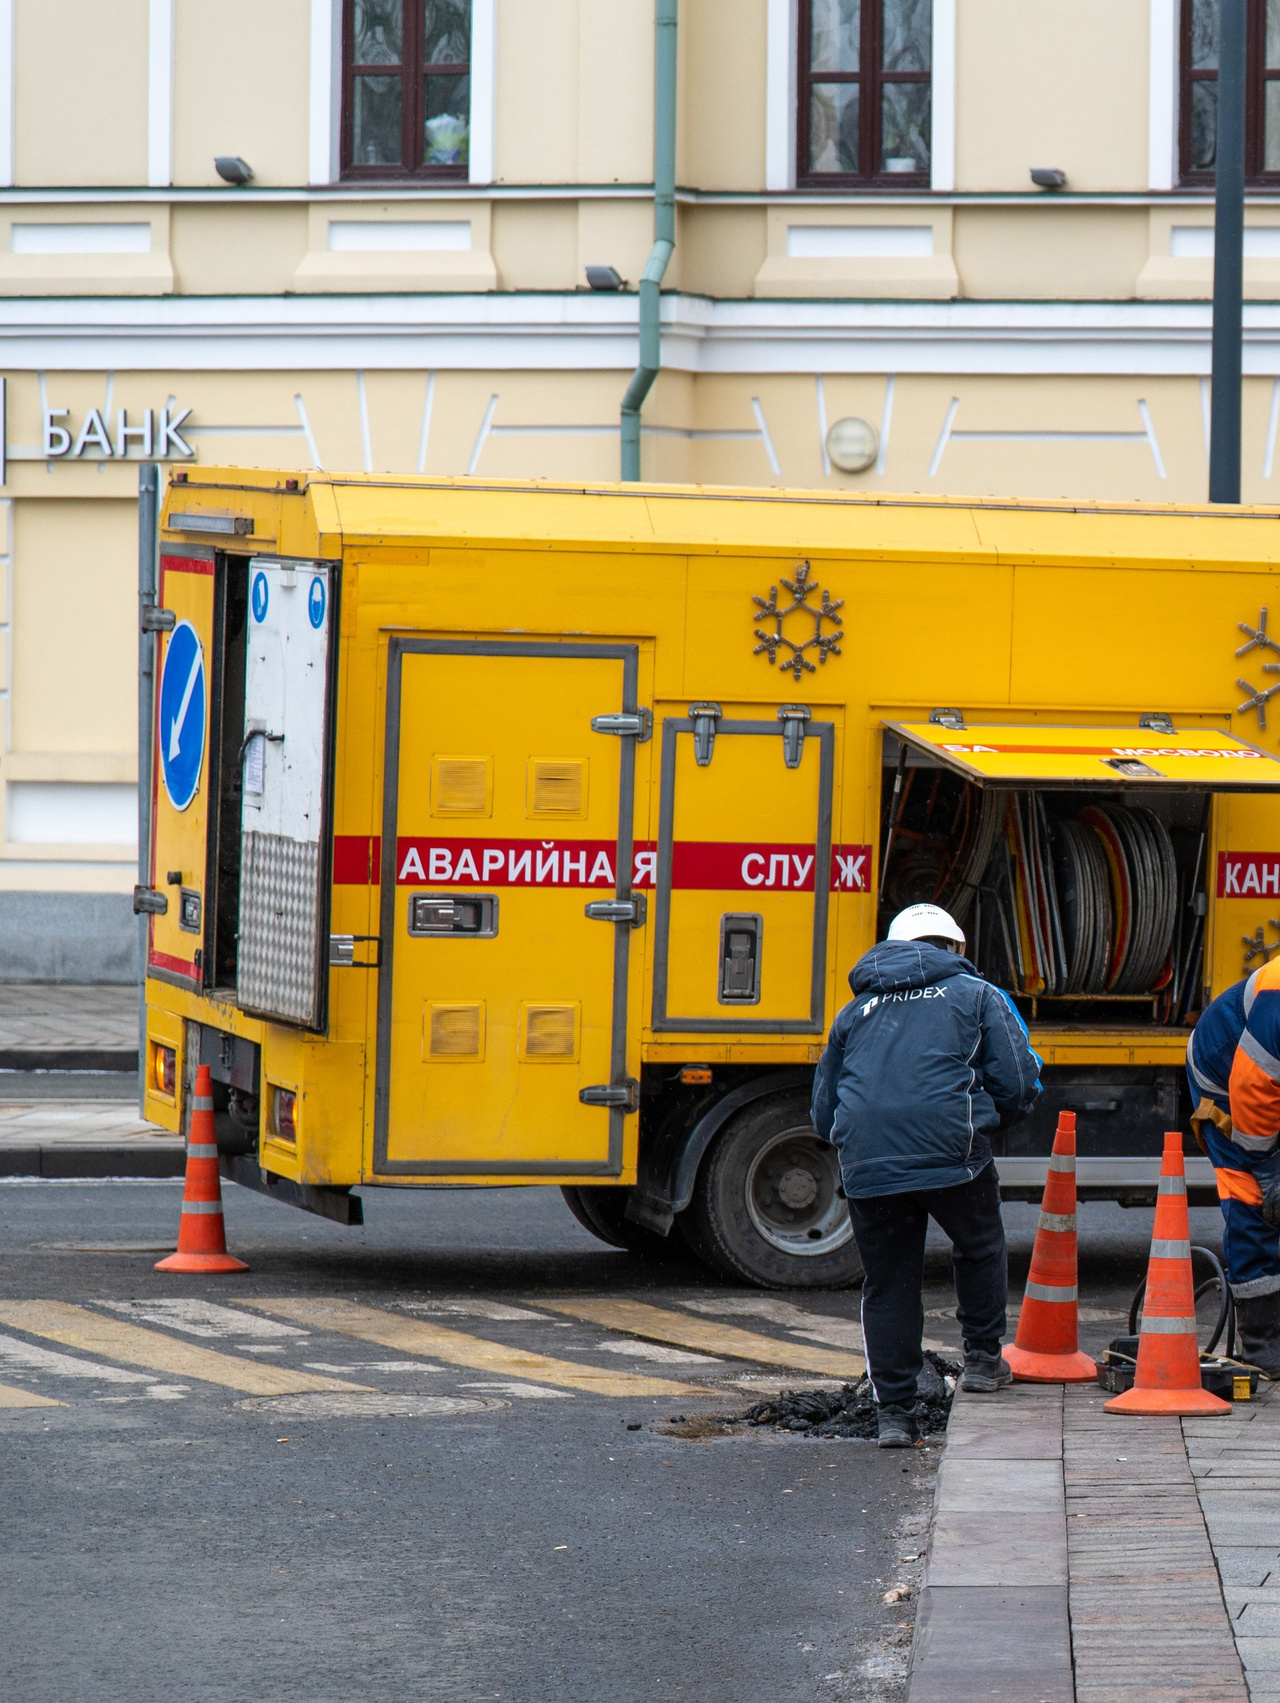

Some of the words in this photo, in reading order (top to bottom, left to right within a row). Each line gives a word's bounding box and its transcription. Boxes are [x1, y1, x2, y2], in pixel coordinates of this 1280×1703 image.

[44, 408, 194, 456] БАНК
[1112, 748, 1261, 758] МОСВОДО
[398, 841, 658, 885] АВАРИЙНАЯ
[740, 852, 866, 888] СЛУЖ
[881, 986, 948, 1003] PRIDEX
